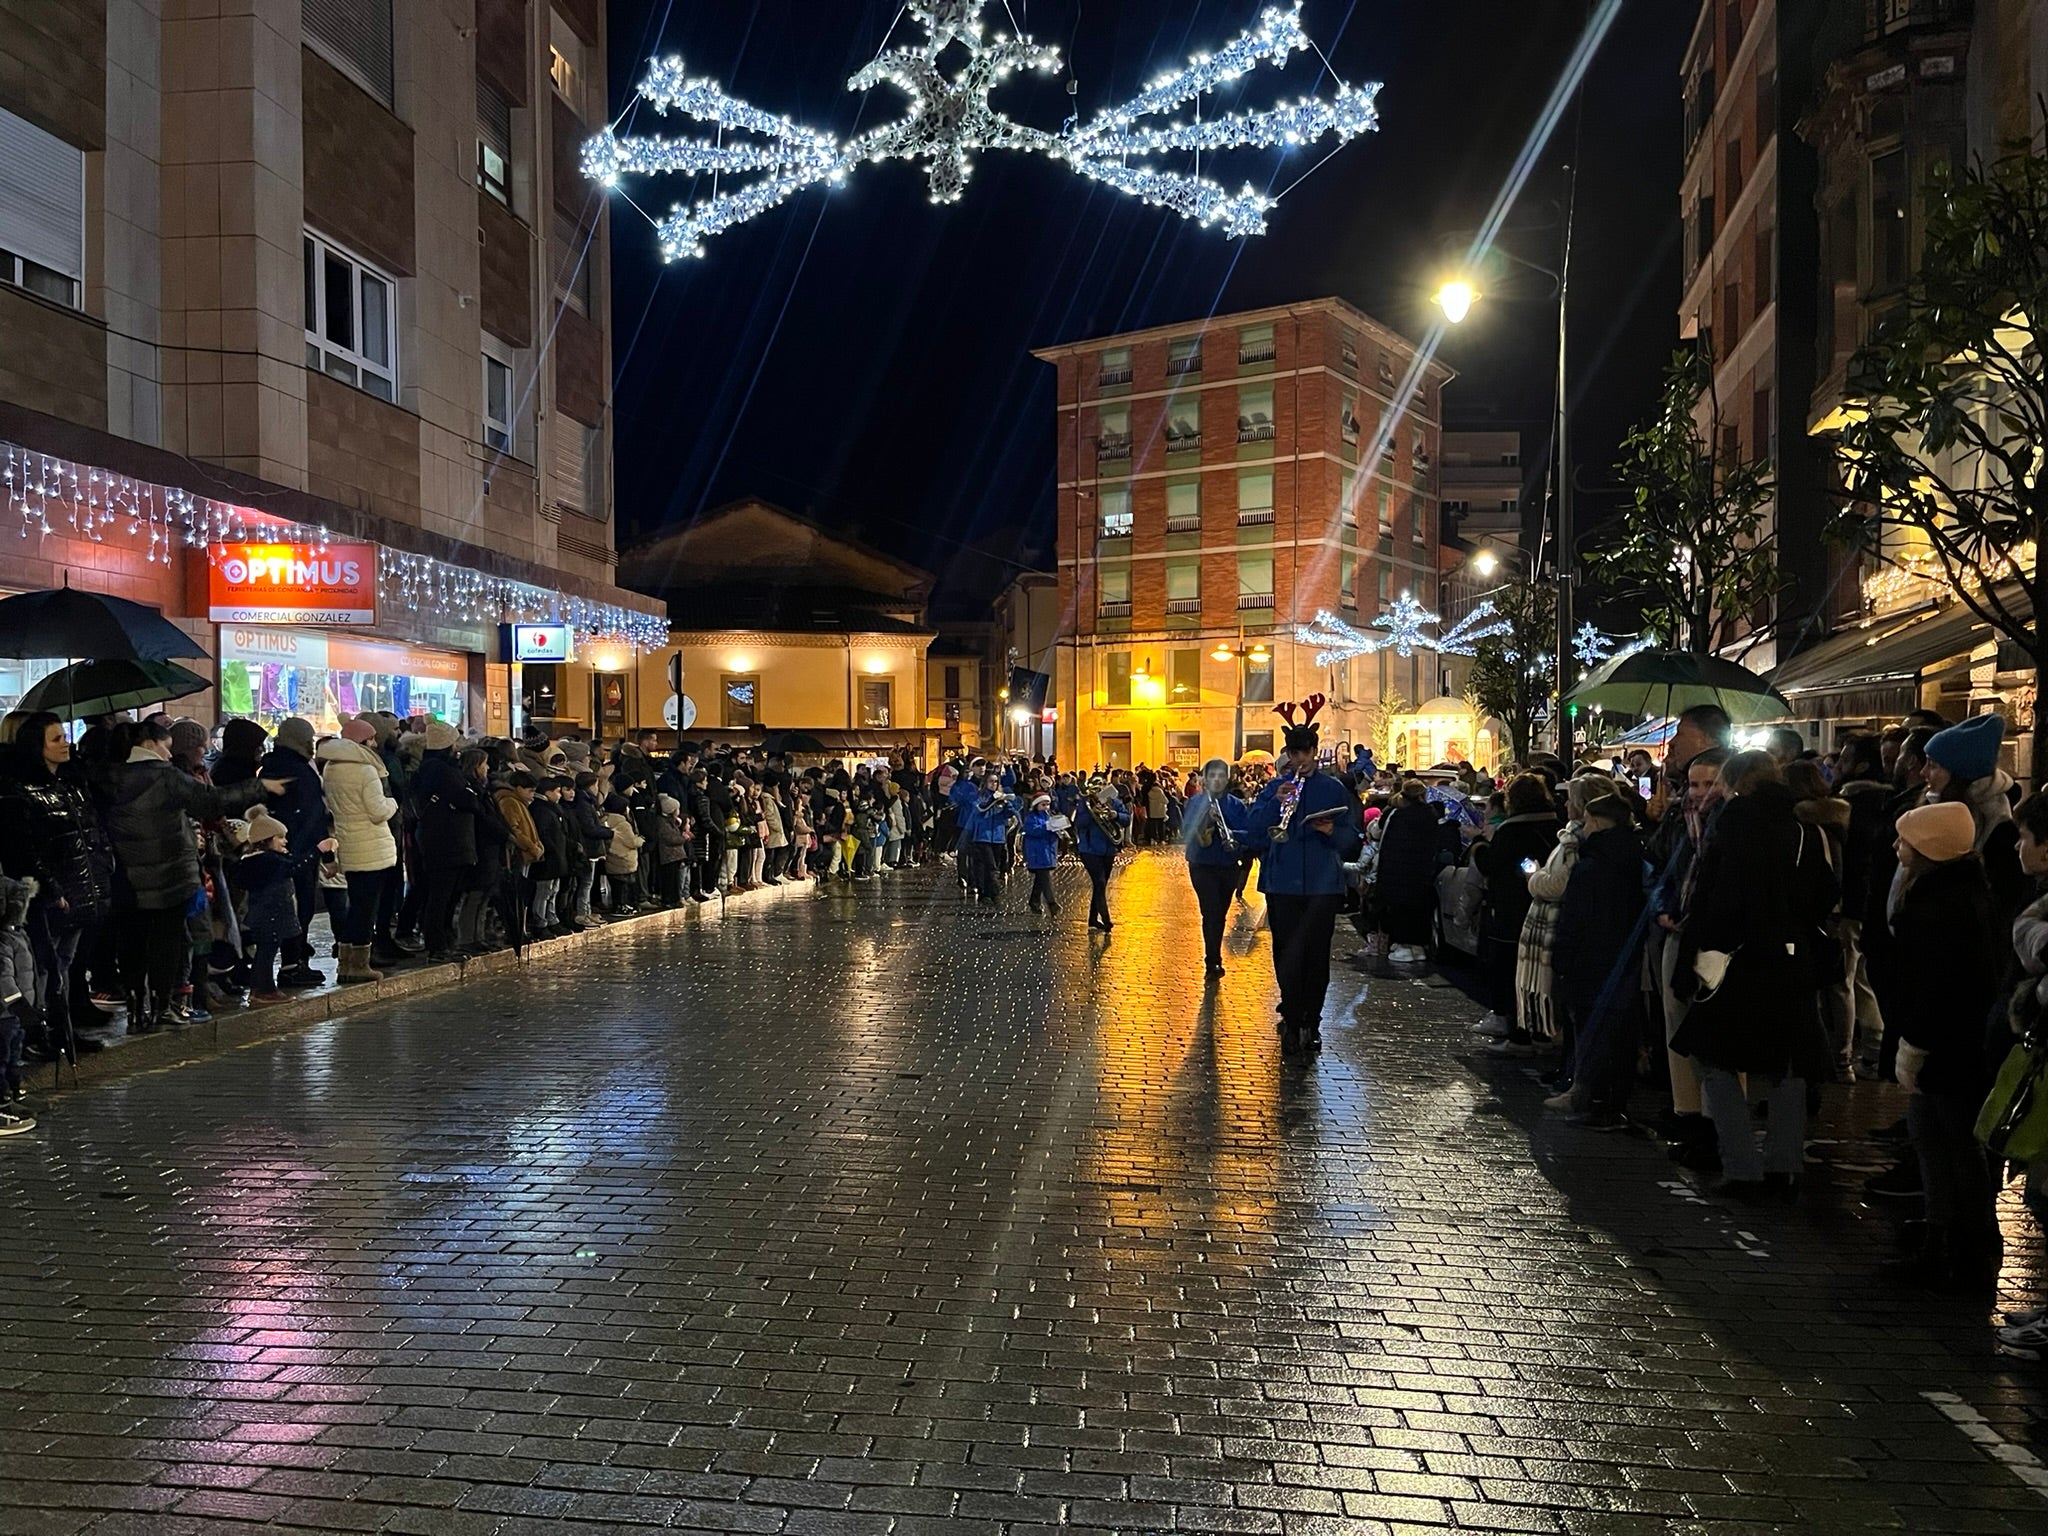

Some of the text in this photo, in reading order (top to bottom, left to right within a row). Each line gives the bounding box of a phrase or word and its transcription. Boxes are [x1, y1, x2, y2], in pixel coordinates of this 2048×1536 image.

[224, 558, 360, 585] OPTIMUS
[232, 611, 351, 622] COMERCIAL GONZALEZ
[235, 630, 297, 653] OPTIMUS
